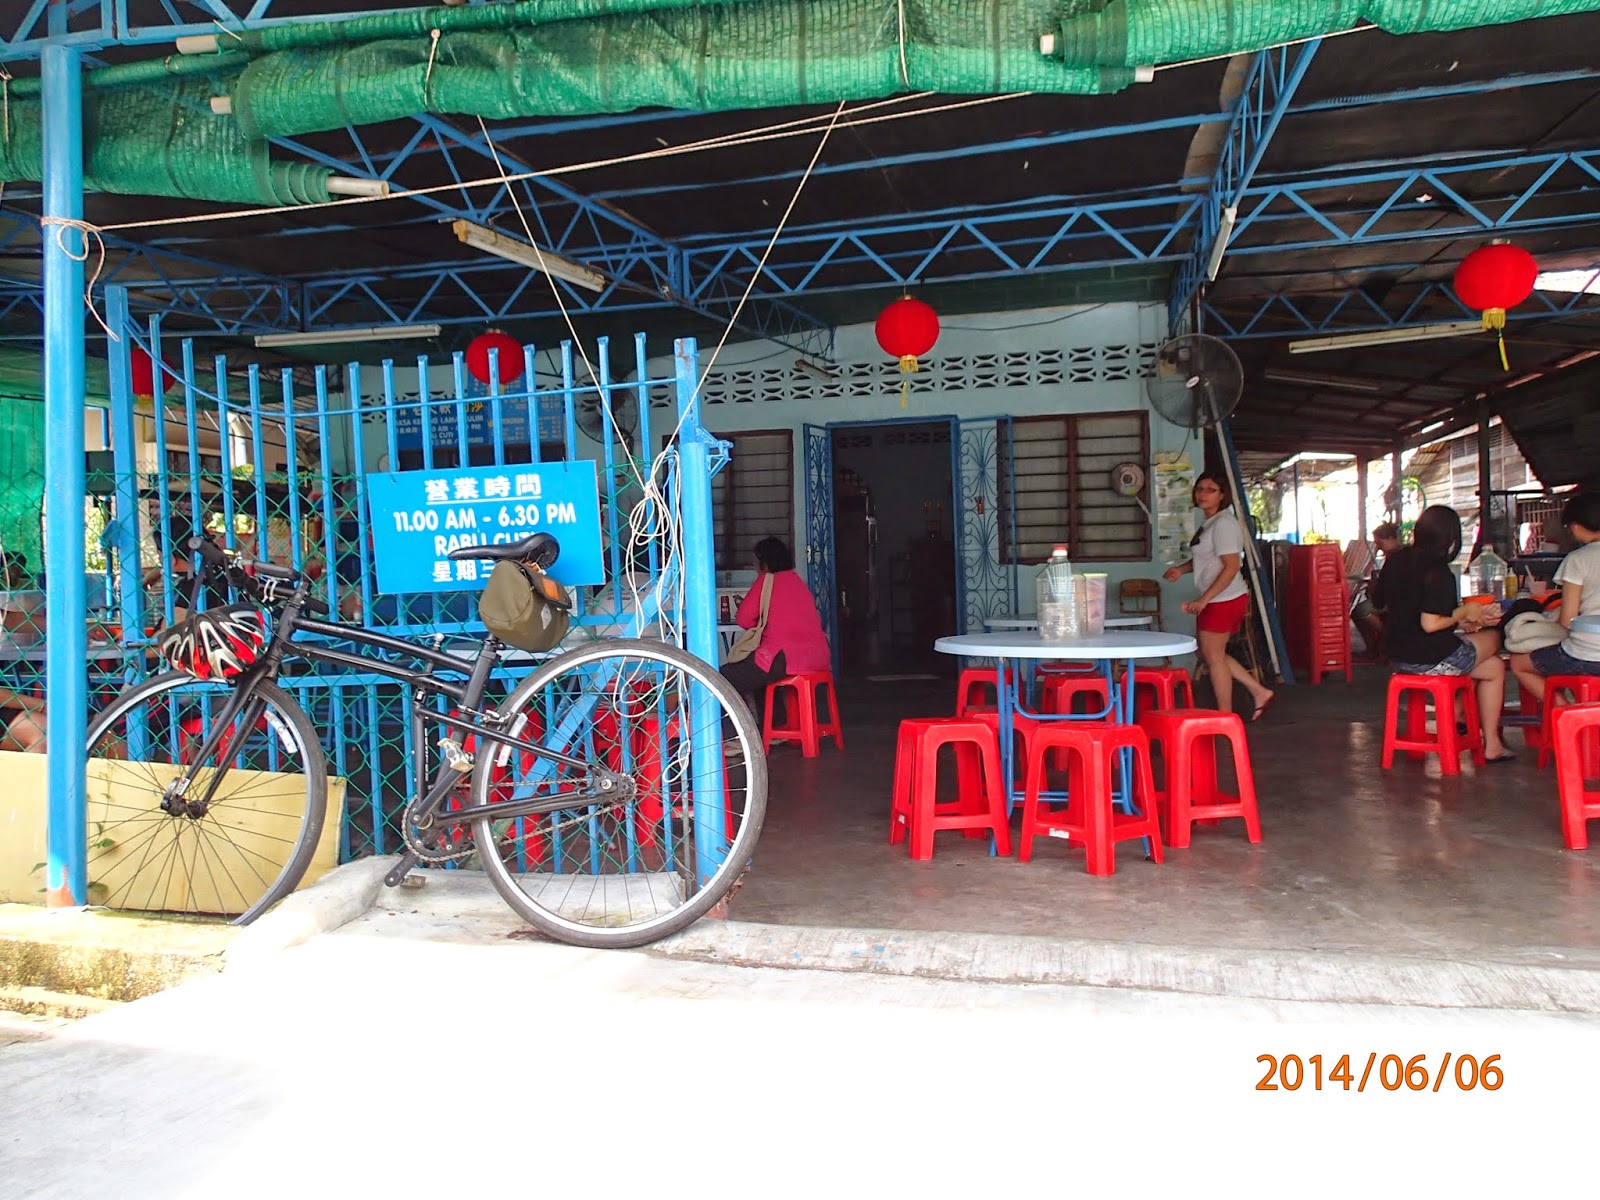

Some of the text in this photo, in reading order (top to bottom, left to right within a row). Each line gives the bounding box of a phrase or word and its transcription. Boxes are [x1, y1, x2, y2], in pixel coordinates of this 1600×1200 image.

[393, 509, 439, 532] 11.00
[445, 508, 476, 530] AM
[498, 504, 539, 527] 6.30
[546, 502, 576, 525] PM
